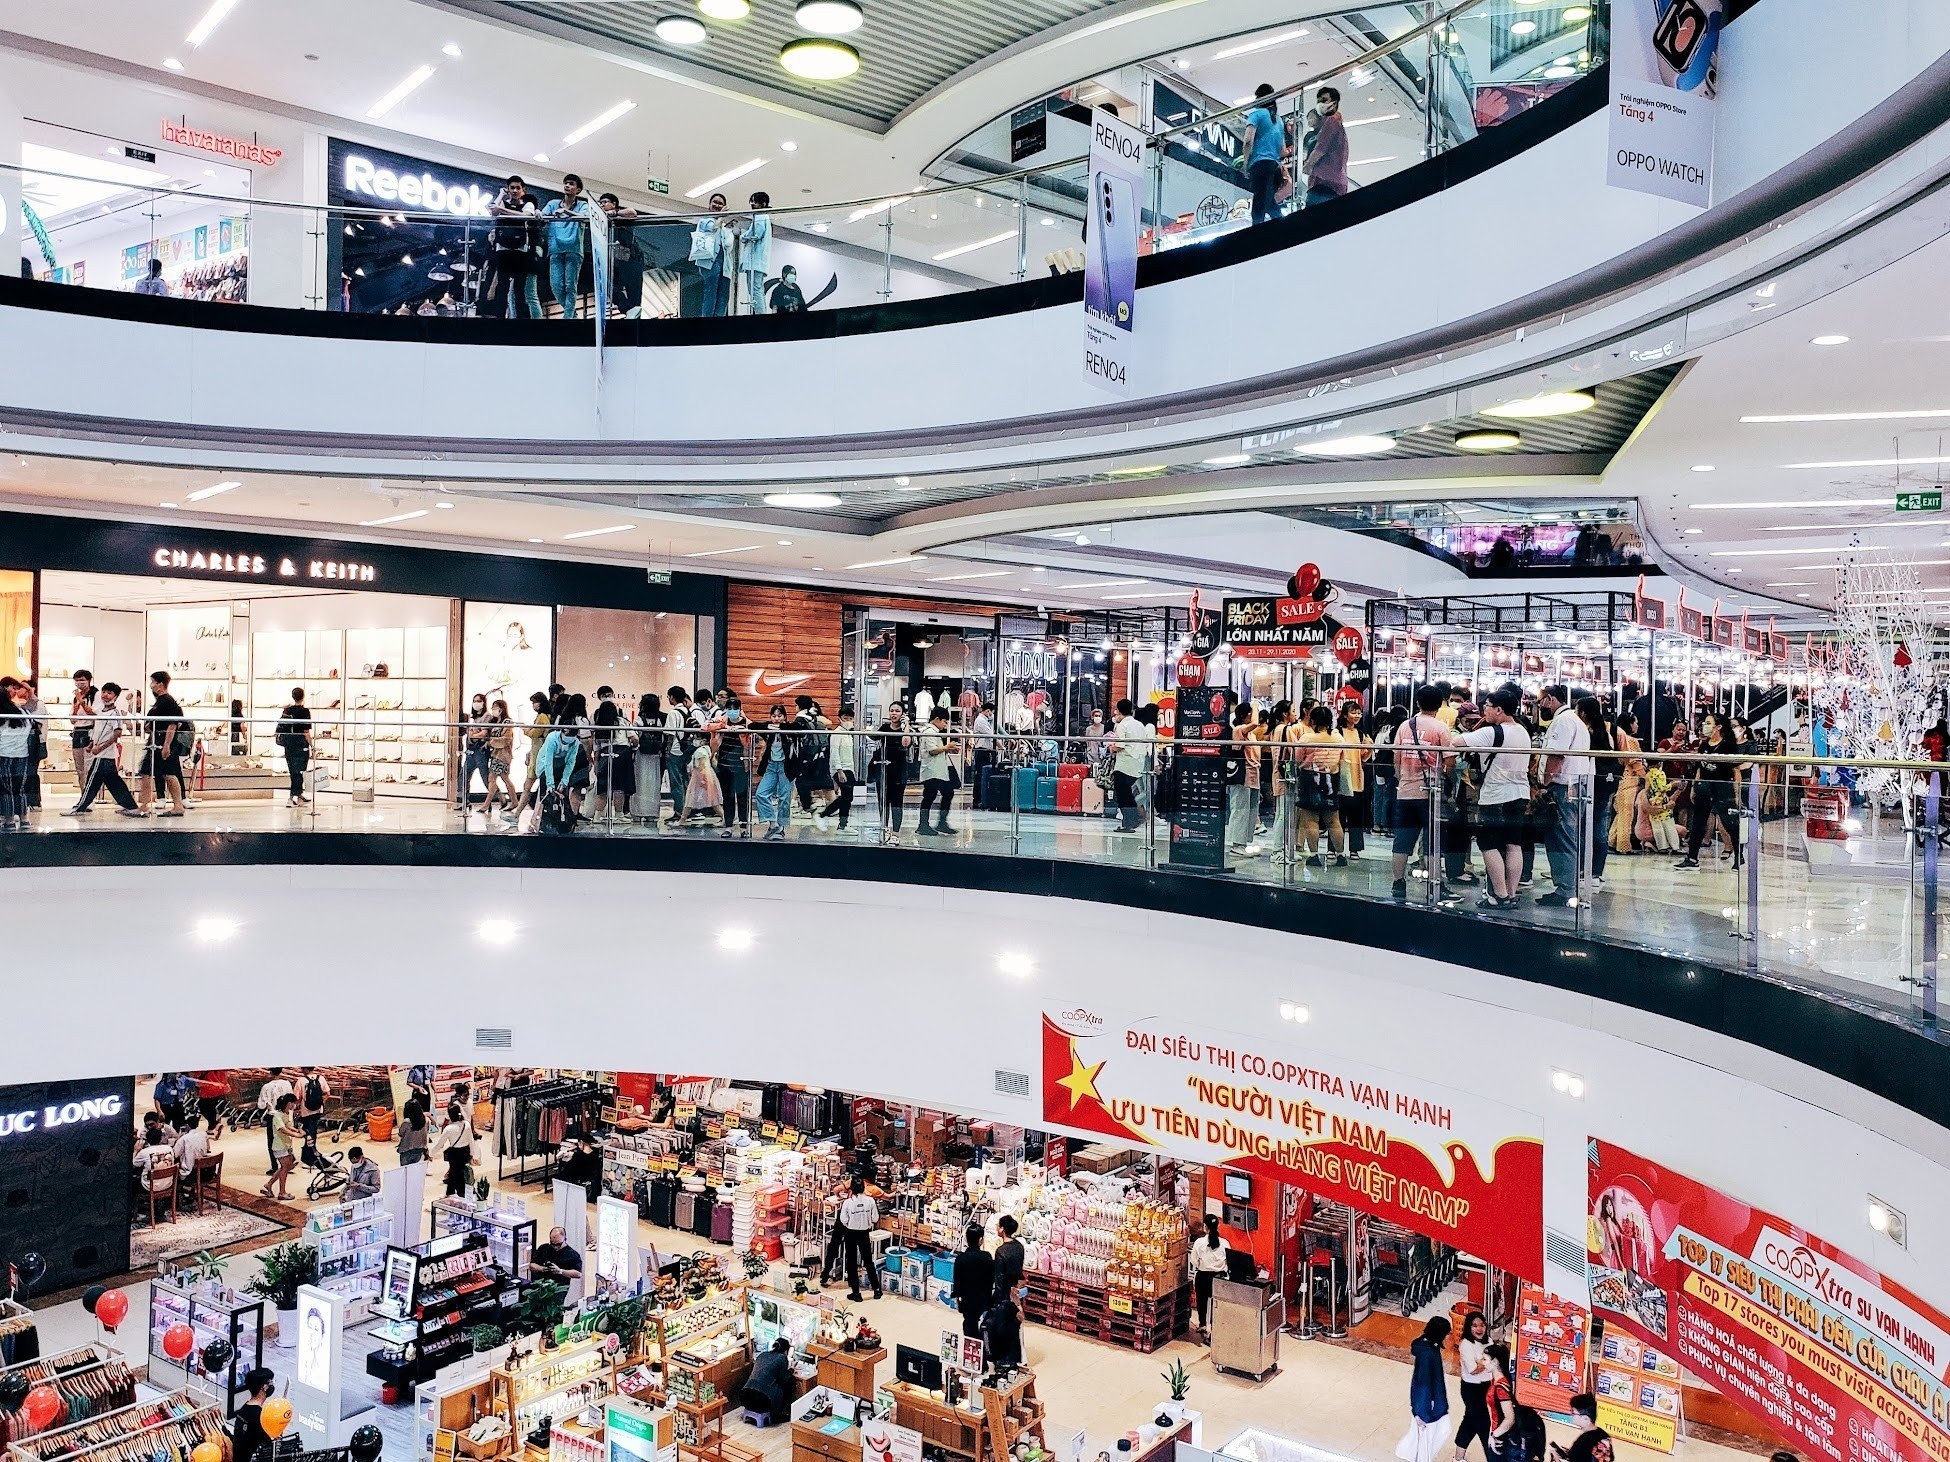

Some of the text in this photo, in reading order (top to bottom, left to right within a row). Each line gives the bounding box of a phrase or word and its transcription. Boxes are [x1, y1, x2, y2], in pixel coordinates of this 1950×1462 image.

[1620, 93, 1687, 115] Trải nghiệm OPPO Store
[1648, 111, 1654, 122] 4
[160, 118, 275, 166] havaianas
[1095, 121, 1141, 163] RENO4
[345, 154, 493, 217] Reebok
[1617, 149, 1704, 186] OPPO WATCH
[1086, 350, 1126, 385] RENO4
[1921, 497, 1941, 507] EXIT
[154, 548, 375, 582] CHARLES & KEITH
[1227, 614, 1270, 626] FRIDAY
[1228, 602, 1315, 618] BLACK SALE
[1226, 625, 1324, 642] LỚN NHẤT NĂM
[1336, 637, 1359, 649] SALE
[989, 649, 1021, 679] JST
[1126, 1030, 1451, 1131] ĐẠI SIÊU THỊ CO.OPXTRA VẠN HẠNH
[44, 1094, 122, 1128] LONG
[1279, 1099, 1326, 1136] VIỆT
[1332, 1114, 1388, 1158] NAM
[1111, 1098, 1146, 1126] ƯU
[1151, 1106, 1200, 1139] TIÊN
[1206, 1117, 1272, 1162] DÙNG
[1275, 1136, 1341, 1184] HÀNG
[1344, 1160, 1397, 1204] VIỆT
[1677, 1233, 1708, 1267] TOP
[1710, 1249, 1724, 1277] 17
[1726, 1259, 1757, 1296] SIÊU
[1758, 1276, 1782, 1316] THỊ
[1784, 1290, 1819, 1335] PHẢI
[1821, 1314, 1854, 1357] ĐẾN
[1856, 1335, 1888, 1380] CỦA
[1889, 1360, 1931, 1411] CHÂU
[1857, 1297, 1872, 1321] SU
[1875, 1307, 1900, 1341] VẠN
[1903, 1326, 1935, 1366] HẠNH
[1687, 1308, 1836, 1422] HÀNG HOÁ chất lượng & đa dạng
[1697, 1275, 1720, 1305] Top
[1723, 1291, 1739, 1312] 17
[1740, 1304, 1779, 1338] stores
[1780, 1329, 1805, 1357] you
[1808, 1347, 1842, 1382] must
[1844, 1372, 1875, 1403] visit
[1876, 1394, 1919, 1437] across
[1688, 1327, 1721, 1357] KHÔNG
[1722, 1351, 1745, 1374] GIAN
[1746, 1364, 1766, 1388] hiện
[1793, 1399, 1813, 1421] cao
[1814, 1413, 1835, 1437] cấp
[1688, 1345, 1713, 1370] PHỤC
[1713, 1360, 1727, 1382] VỤ
[1728, 1372, 1761, 1403] chuyên
[1761, 1395, 1794, 1427] nghiệp
[1795, 1416, 1803, 1432] &
[1804, 1424, 1820, 1445] tận
[1821, 1436, 1842, 1462] tâm
